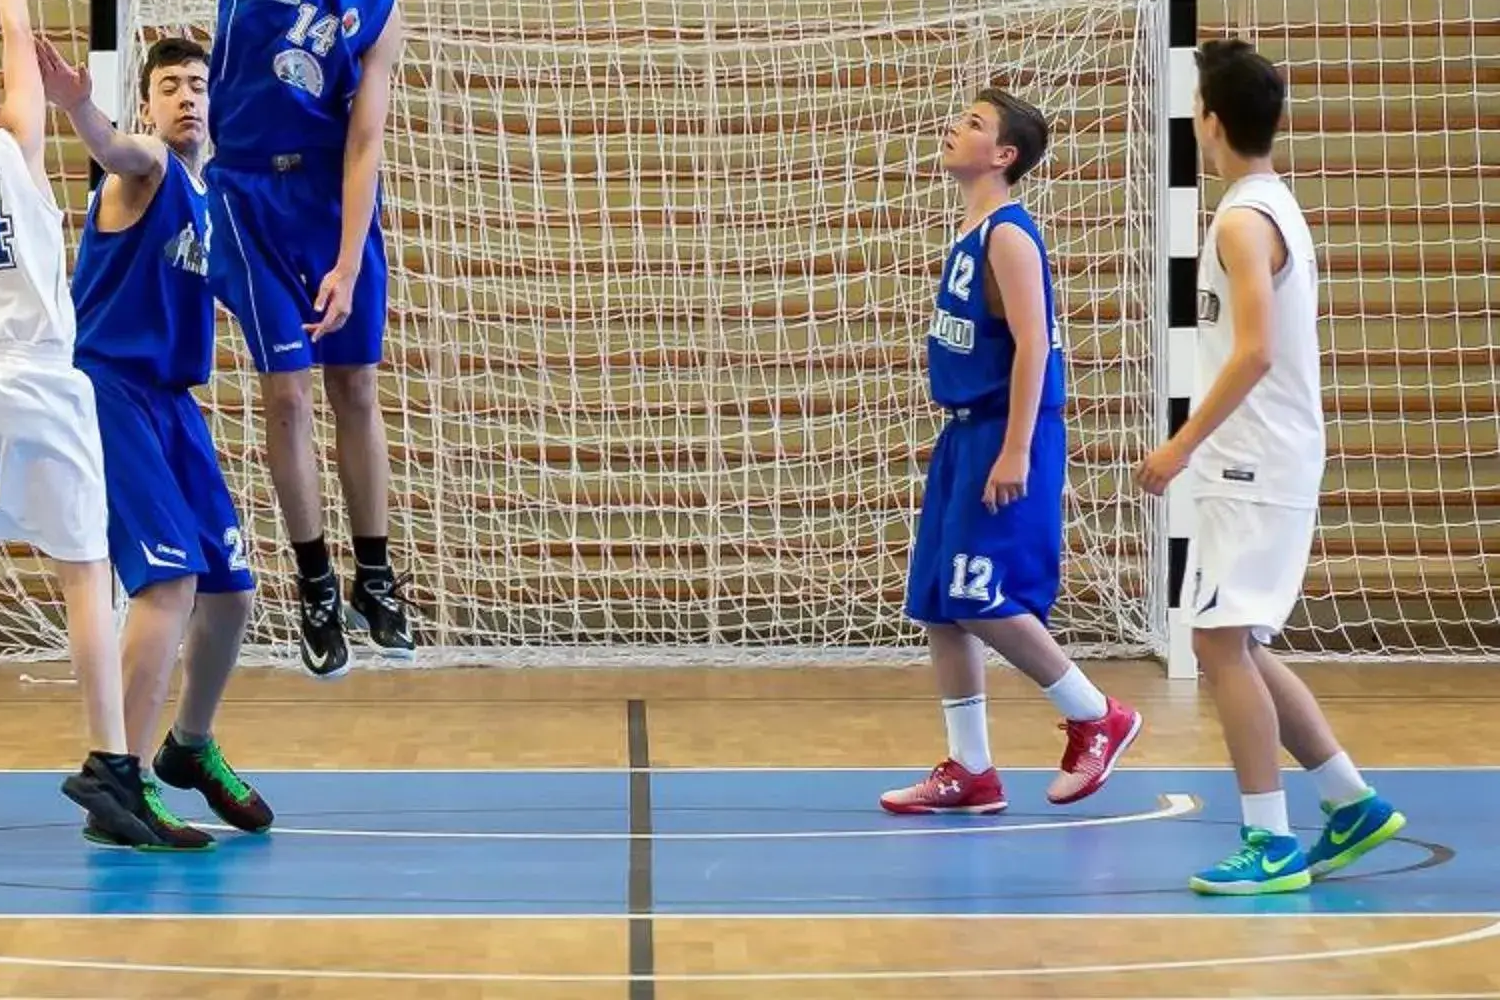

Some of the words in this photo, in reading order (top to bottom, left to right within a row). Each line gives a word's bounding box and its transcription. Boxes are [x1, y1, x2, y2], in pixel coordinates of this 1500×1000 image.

[285, 2, 340, 57] 14
[947, 250, 975, 301] 12
[948, 553, 993, 601] 12
